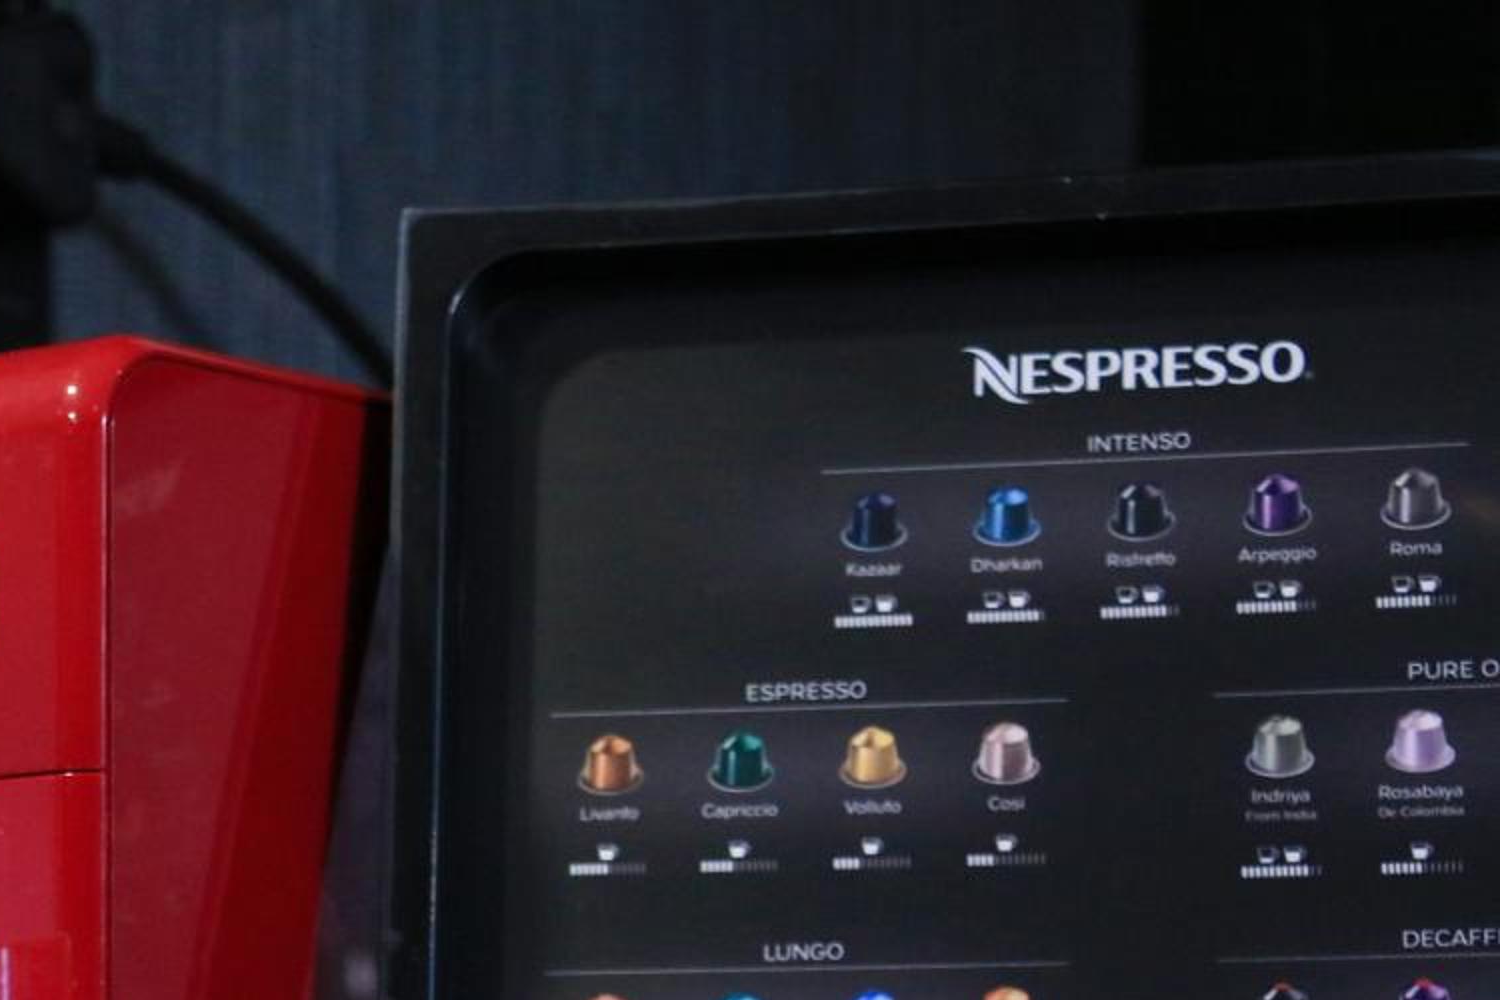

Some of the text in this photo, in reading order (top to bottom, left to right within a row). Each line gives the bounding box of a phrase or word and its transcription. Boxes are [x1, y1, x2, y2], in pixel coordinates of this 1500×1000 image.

[963, 340, 1306, 405] NESPRESSO
[1087, 431, 1192, 453] INTENSO
[1237, 546, 1317, 564] Arpeggio
[1389, 540, 1443, 556] Roma
[970, 557, 1043, 573] Dharkan
[1407, 659, 1474, 681] PURE
[745, 679, 868, 702] ESPRESSO
[1377, 783, 1464, 801] Rosabaya
[700, 802, 779, 820] Capriccio
[1402, 927, 1500, 949] DECAFF
[763, 941, 845, 963] LUNGO
